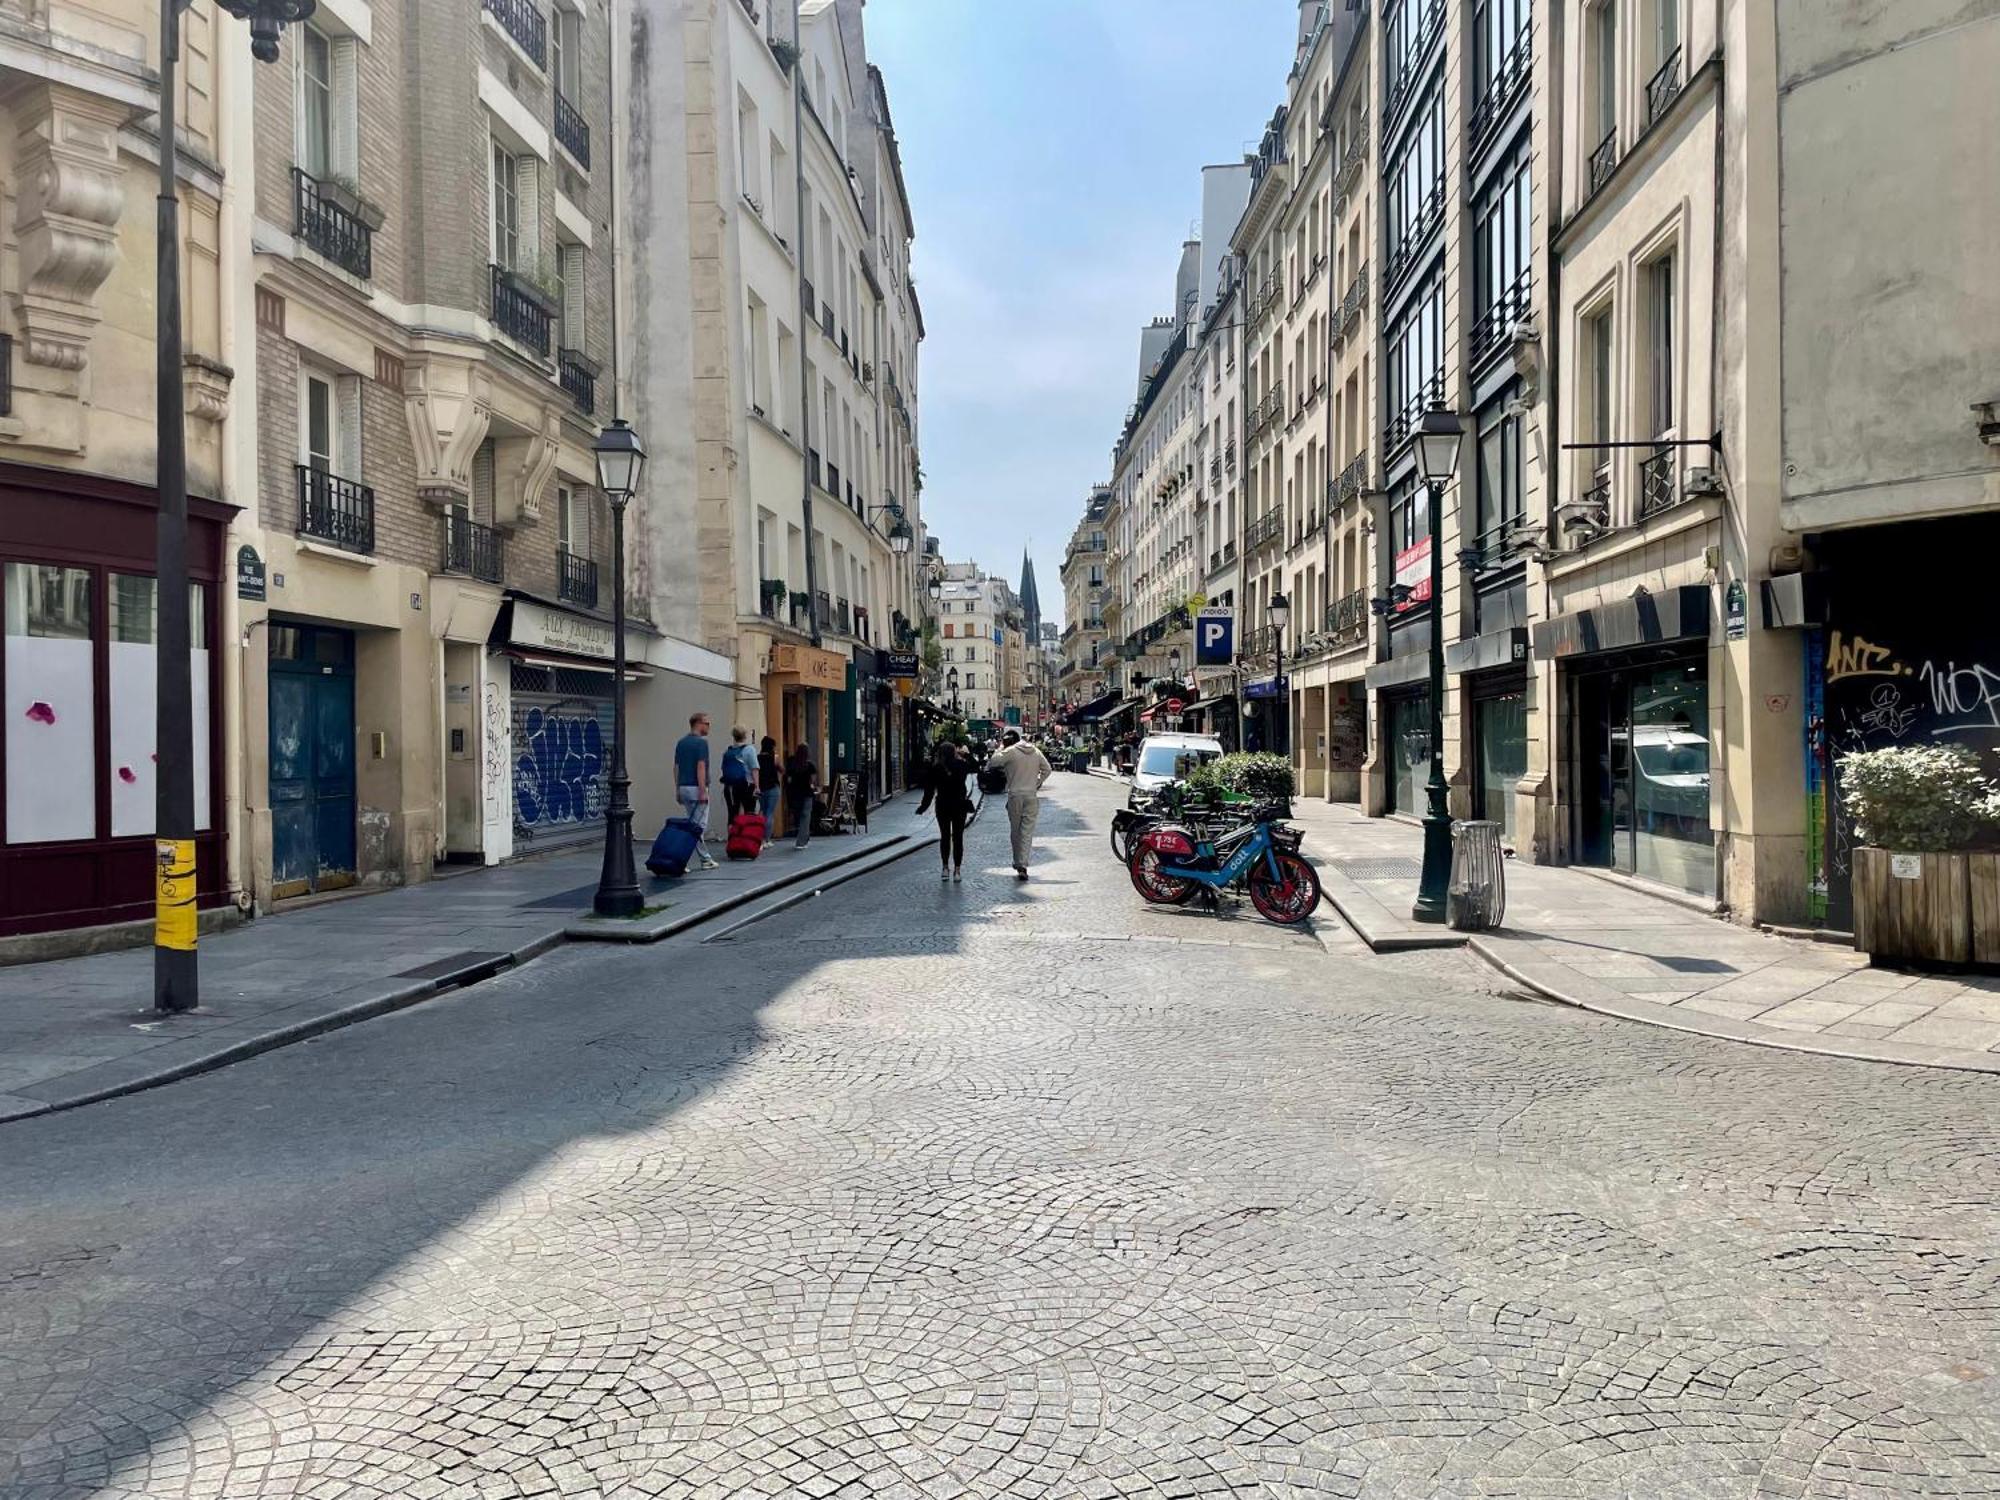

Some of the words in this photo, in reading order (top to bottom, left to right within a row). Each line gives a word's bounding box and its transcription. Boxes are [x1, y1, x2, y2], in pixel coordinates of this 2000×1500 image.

[238, 575, 263, 586] AINT-DENIS
[1205, 624, 1225, 648] P
[889, 655, 916, 663] CHEAP
